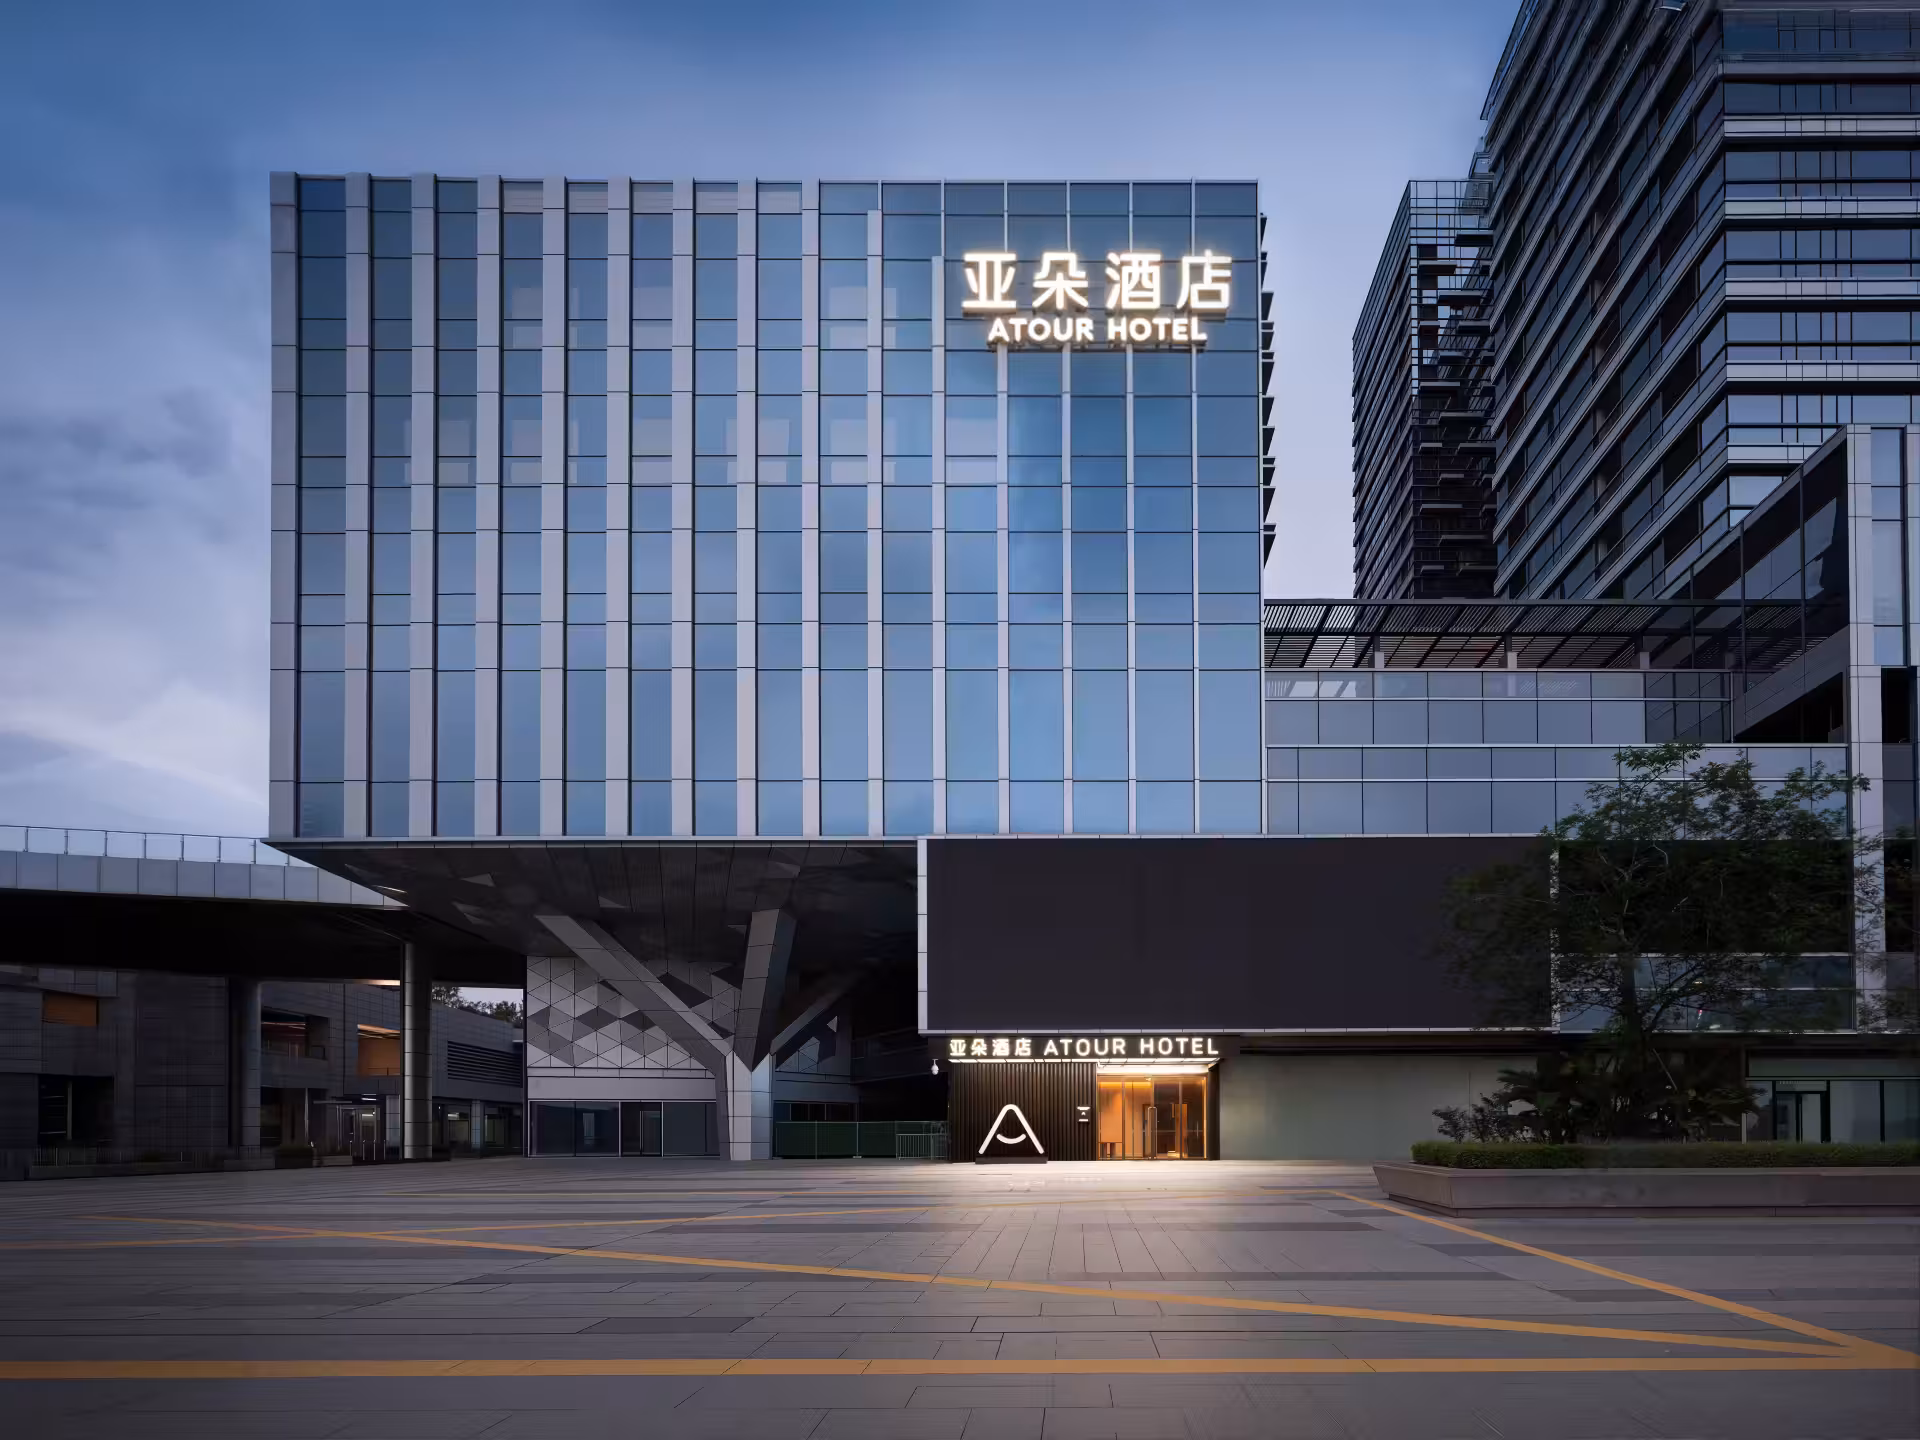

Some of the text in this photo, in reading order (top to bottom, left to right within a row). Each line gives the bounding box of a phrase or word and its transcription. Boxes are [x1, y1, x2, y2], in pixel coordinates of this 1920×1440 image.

[962, 250, 1232, 310] 亚朵酒店
[988, 317, 1207, 341] ATOUR HOTEL
[949, 1038, 1032, 1057] 亚朵酒店
[1044, 1038, 1219, 1056] ATOUR HOTEL
